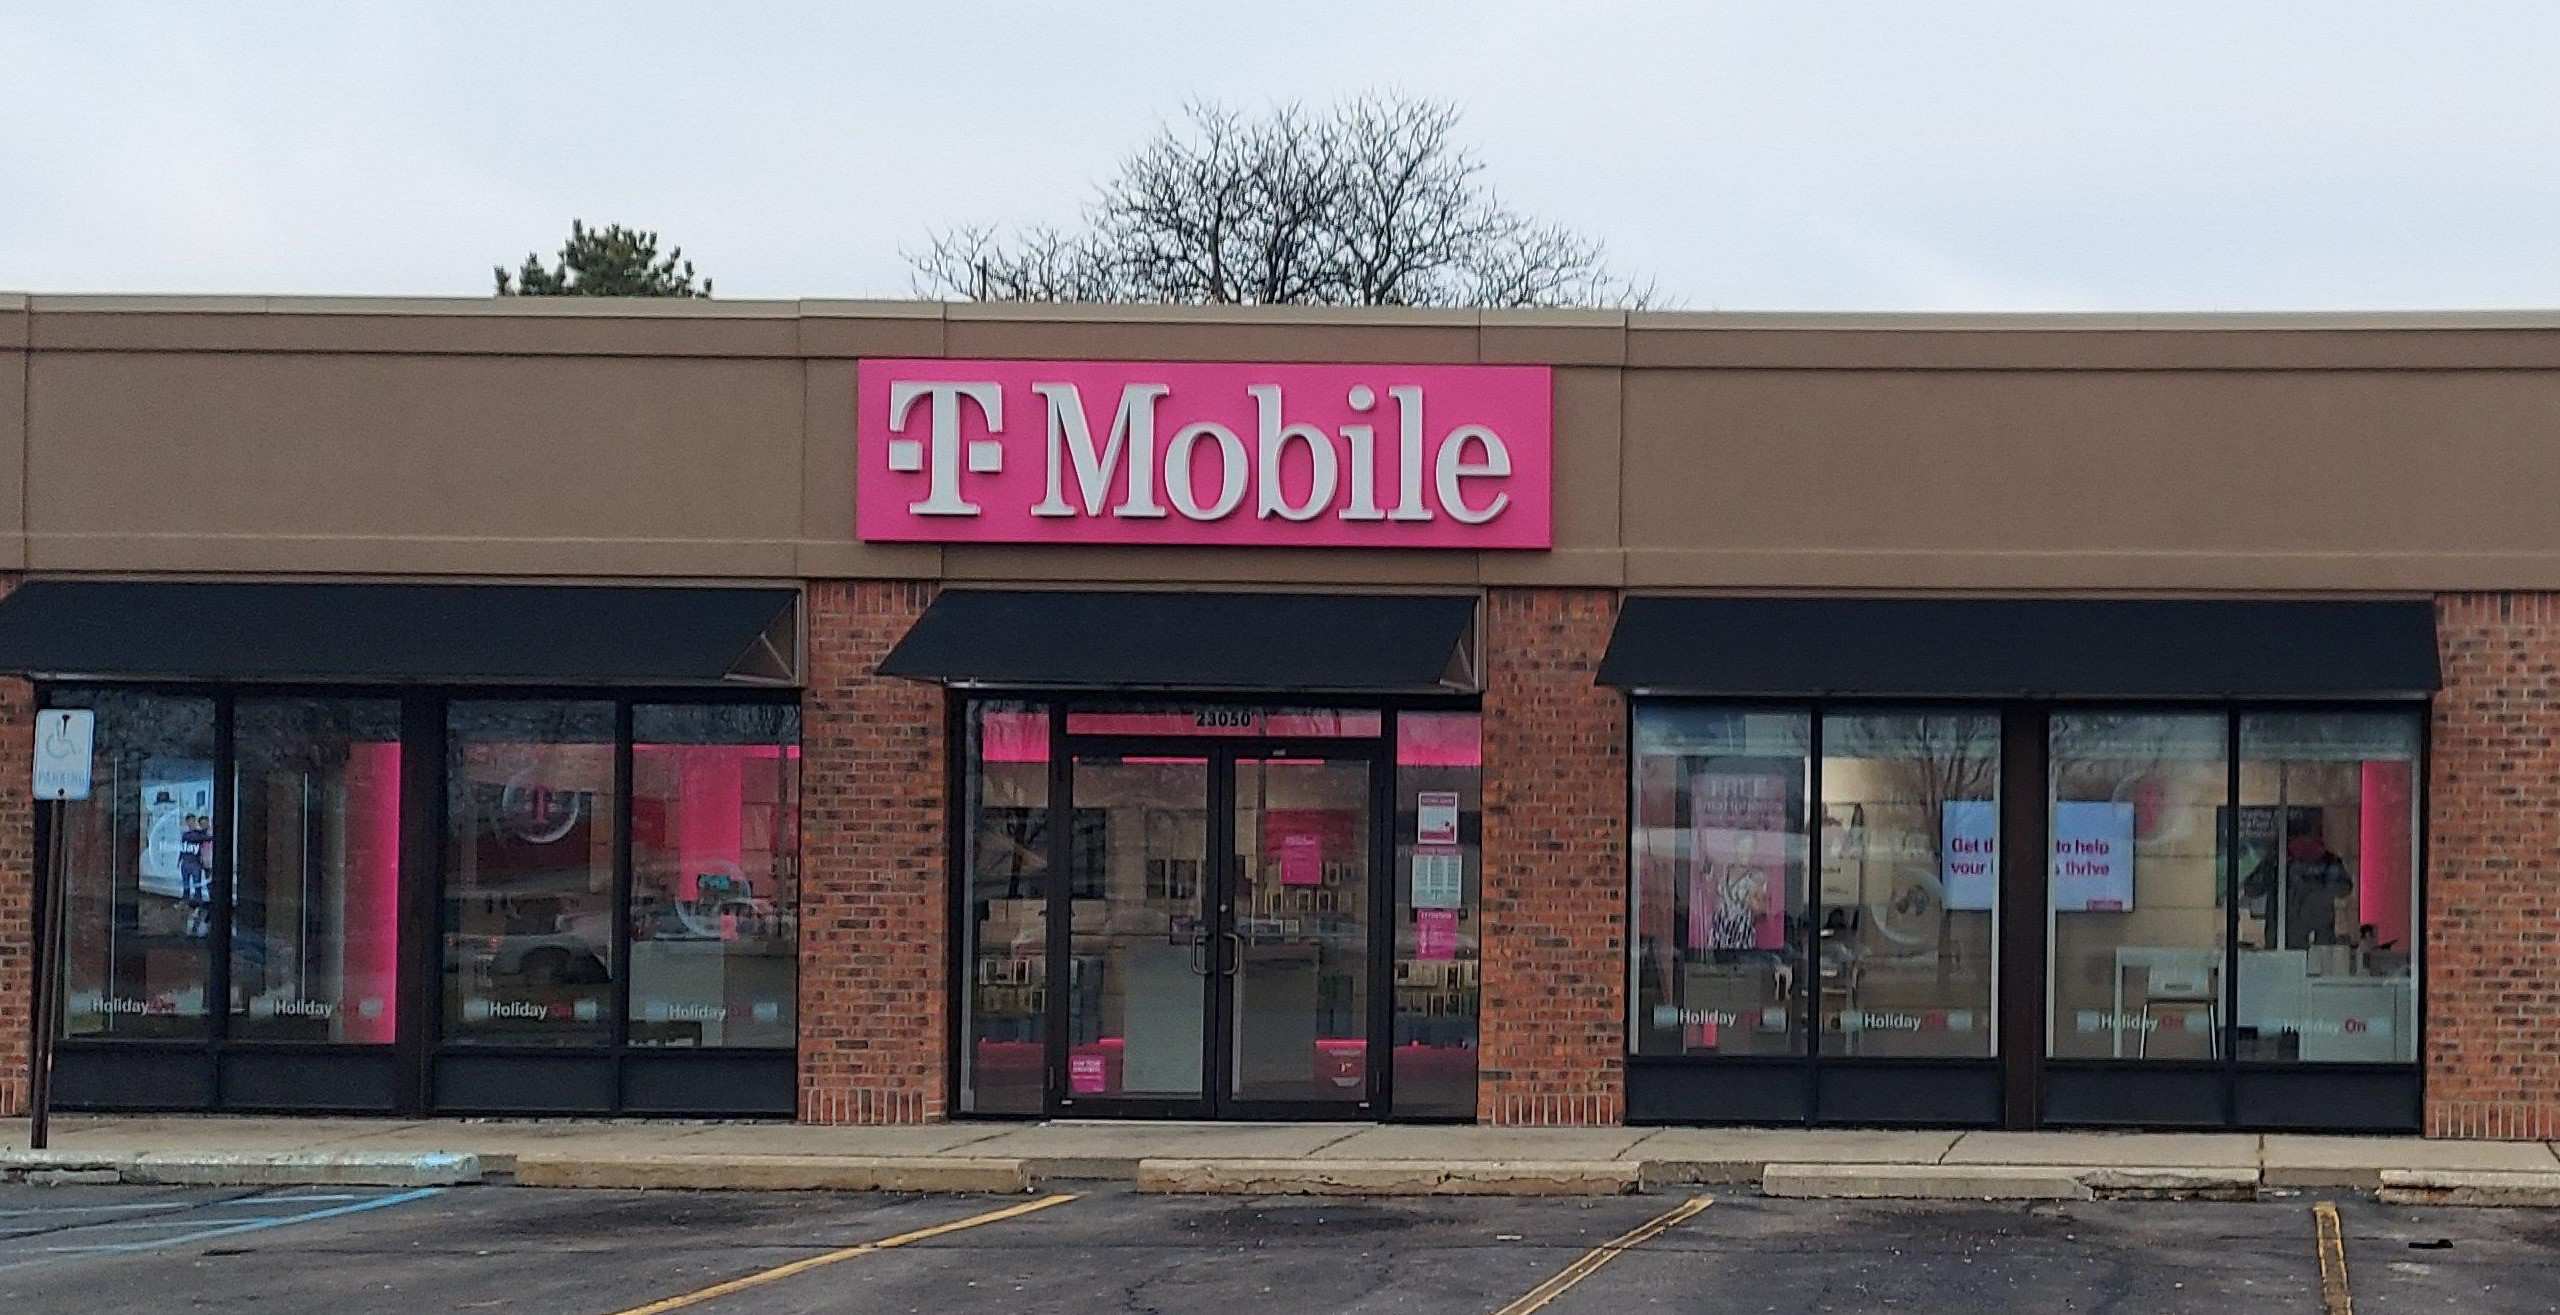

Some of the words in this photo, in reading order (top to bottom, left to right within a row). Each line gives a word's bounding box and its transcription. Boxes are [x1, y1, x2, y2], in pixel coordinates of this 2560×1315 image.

[888, 379, 1004, 517] T
[1030, 381, 1513, 525] Mobile
[1196, 711, 1251, 727] 23050
[1951, 838, 1979, 853] Get
[2075, 838, 2109, 856] help
[1951, 862, 1984, 875] your
[2065, 860, 2110, 876] thrive
[91, 997, 150, 1017] Holiday
[275, 999, 333, 1018] Holiday
[489, 1000, 548, 1020] Holiday
[668, 1003, 727, 1021] Holiday
[1679, 1007, 1737, 1028] Holiday
[1864, 1012, 1921, 1032] Holiday
[2344, 1018, 2366, 1034] On
